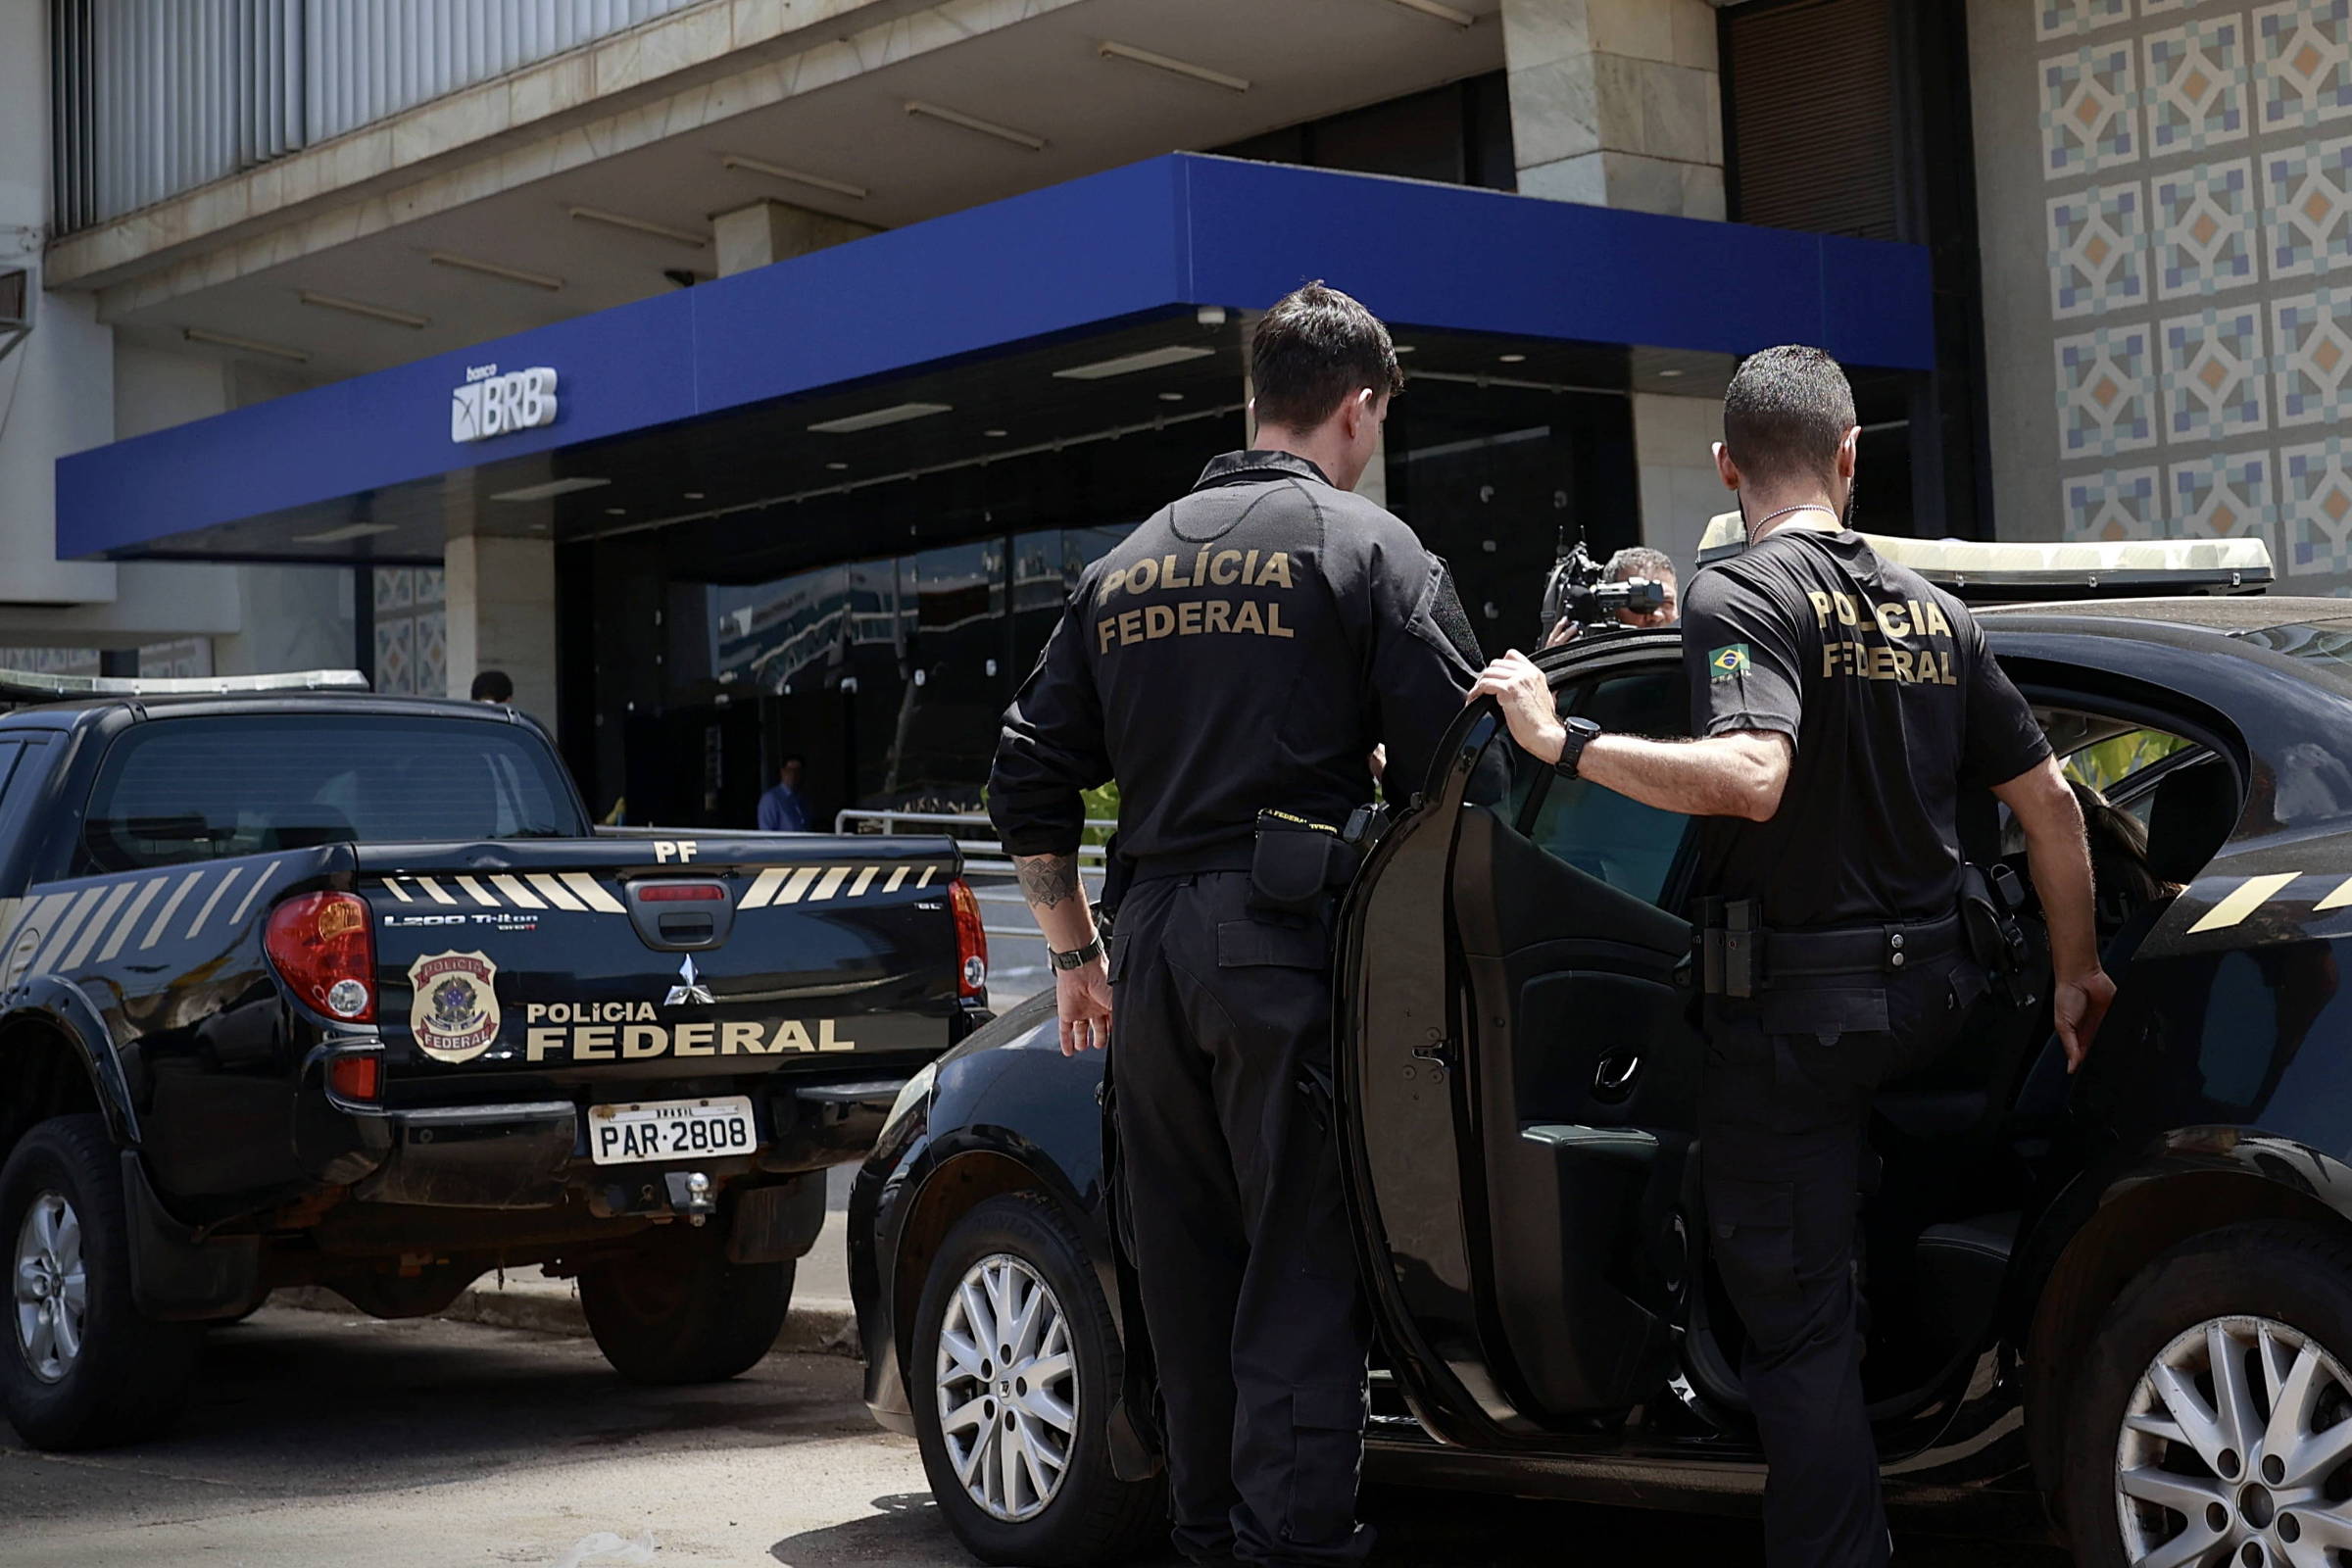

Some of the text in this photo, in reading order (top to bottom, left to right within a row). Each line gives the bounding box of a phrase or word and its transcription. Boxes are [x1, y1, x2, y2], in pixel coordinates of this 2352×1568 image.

[466, 364, 497, 382] banco
[482, 367, 557, 437] BRB
[1098, 543, 1293, 606] POLÍCIA
[1098, 600, 1295, 655] FEDERAL
[1808, 590, 1952, 638] POLCIA
[1823, 641, 1957, 685] FEDERAL
[654, 840, 698, 863] PF
[384, 912, 538, 927] L200 Triton
[424, 1029, 489, 1049] FEDERAL
[526, 1019, 855, 1061] FEDERAL
